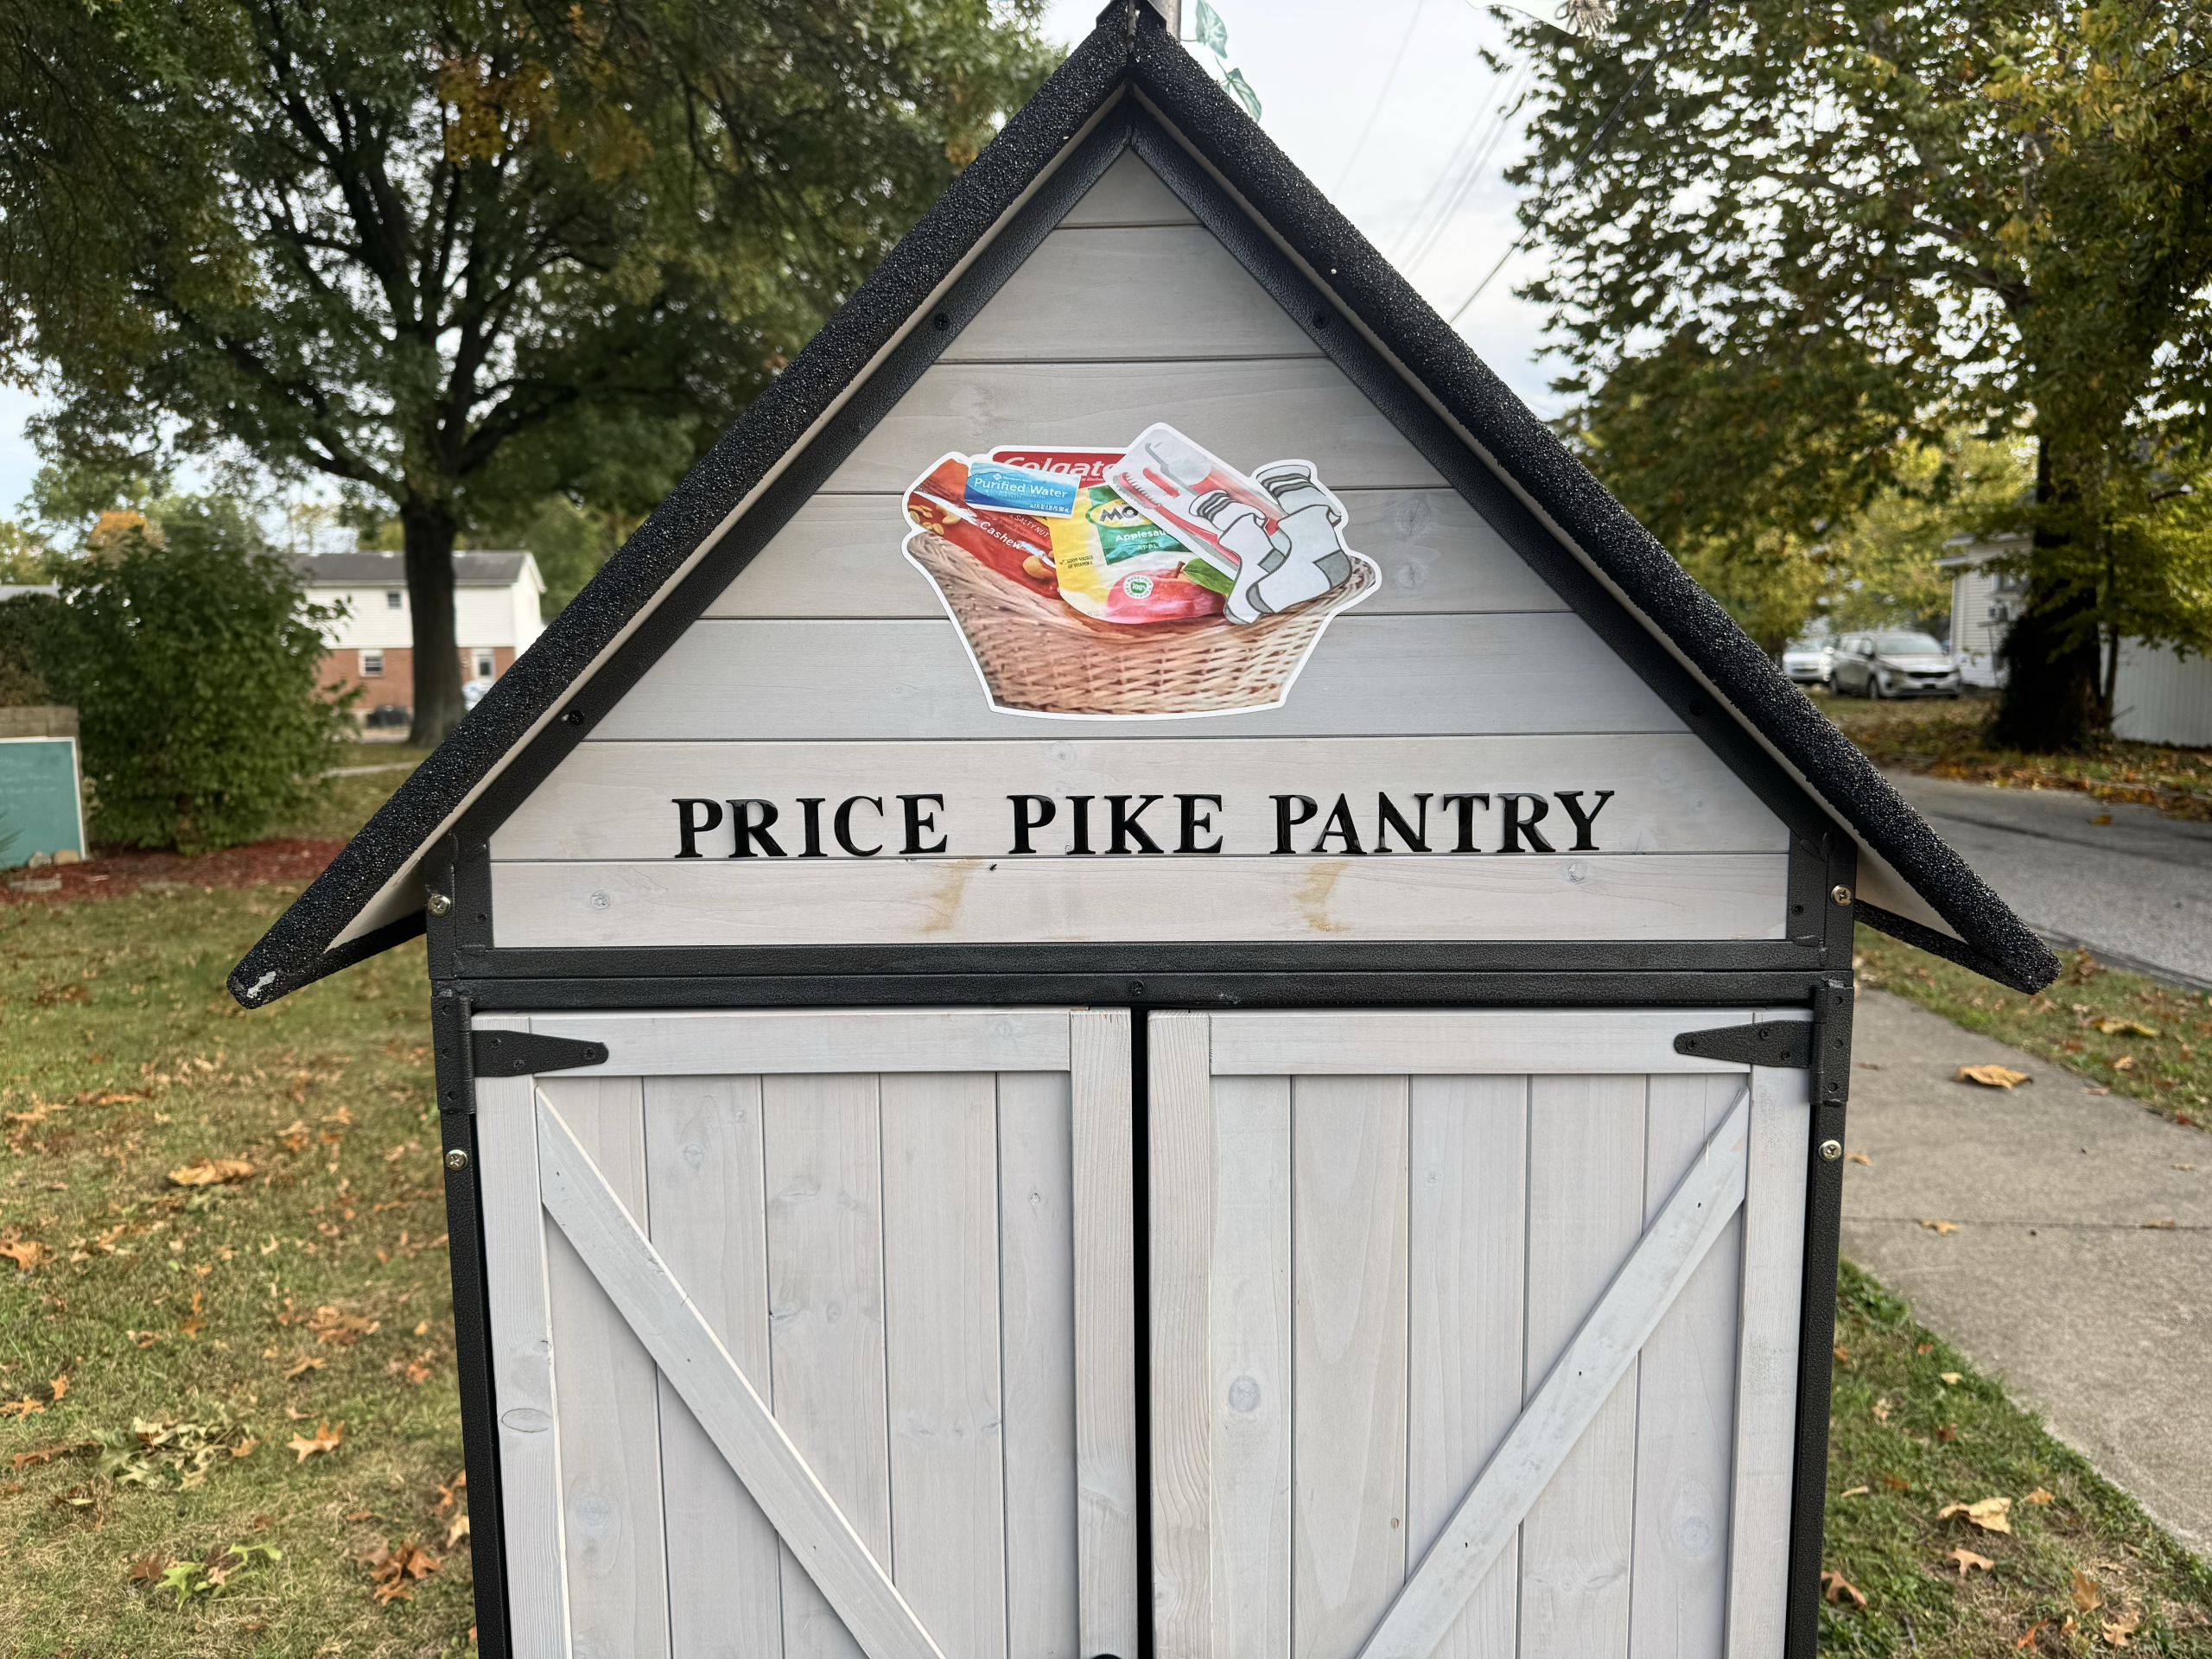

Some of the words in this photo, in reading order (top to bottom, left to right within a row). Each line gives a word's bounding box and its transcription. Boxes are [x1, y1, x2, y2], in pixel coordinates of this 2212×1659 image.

[974, 478, 1026, 493] Purified
[1029, 485, 1068, 498] Water
[980, 521, 1023, 550] Cashew
[1014, 514, 1036, 529] SALTY
[1034, 526, 1049, 537] NUT
[671, 793, 948, 858] PRICE
[1006, 793, 1224, 855] PIKE
[1268, 790, 1615, 855] PANTRY
